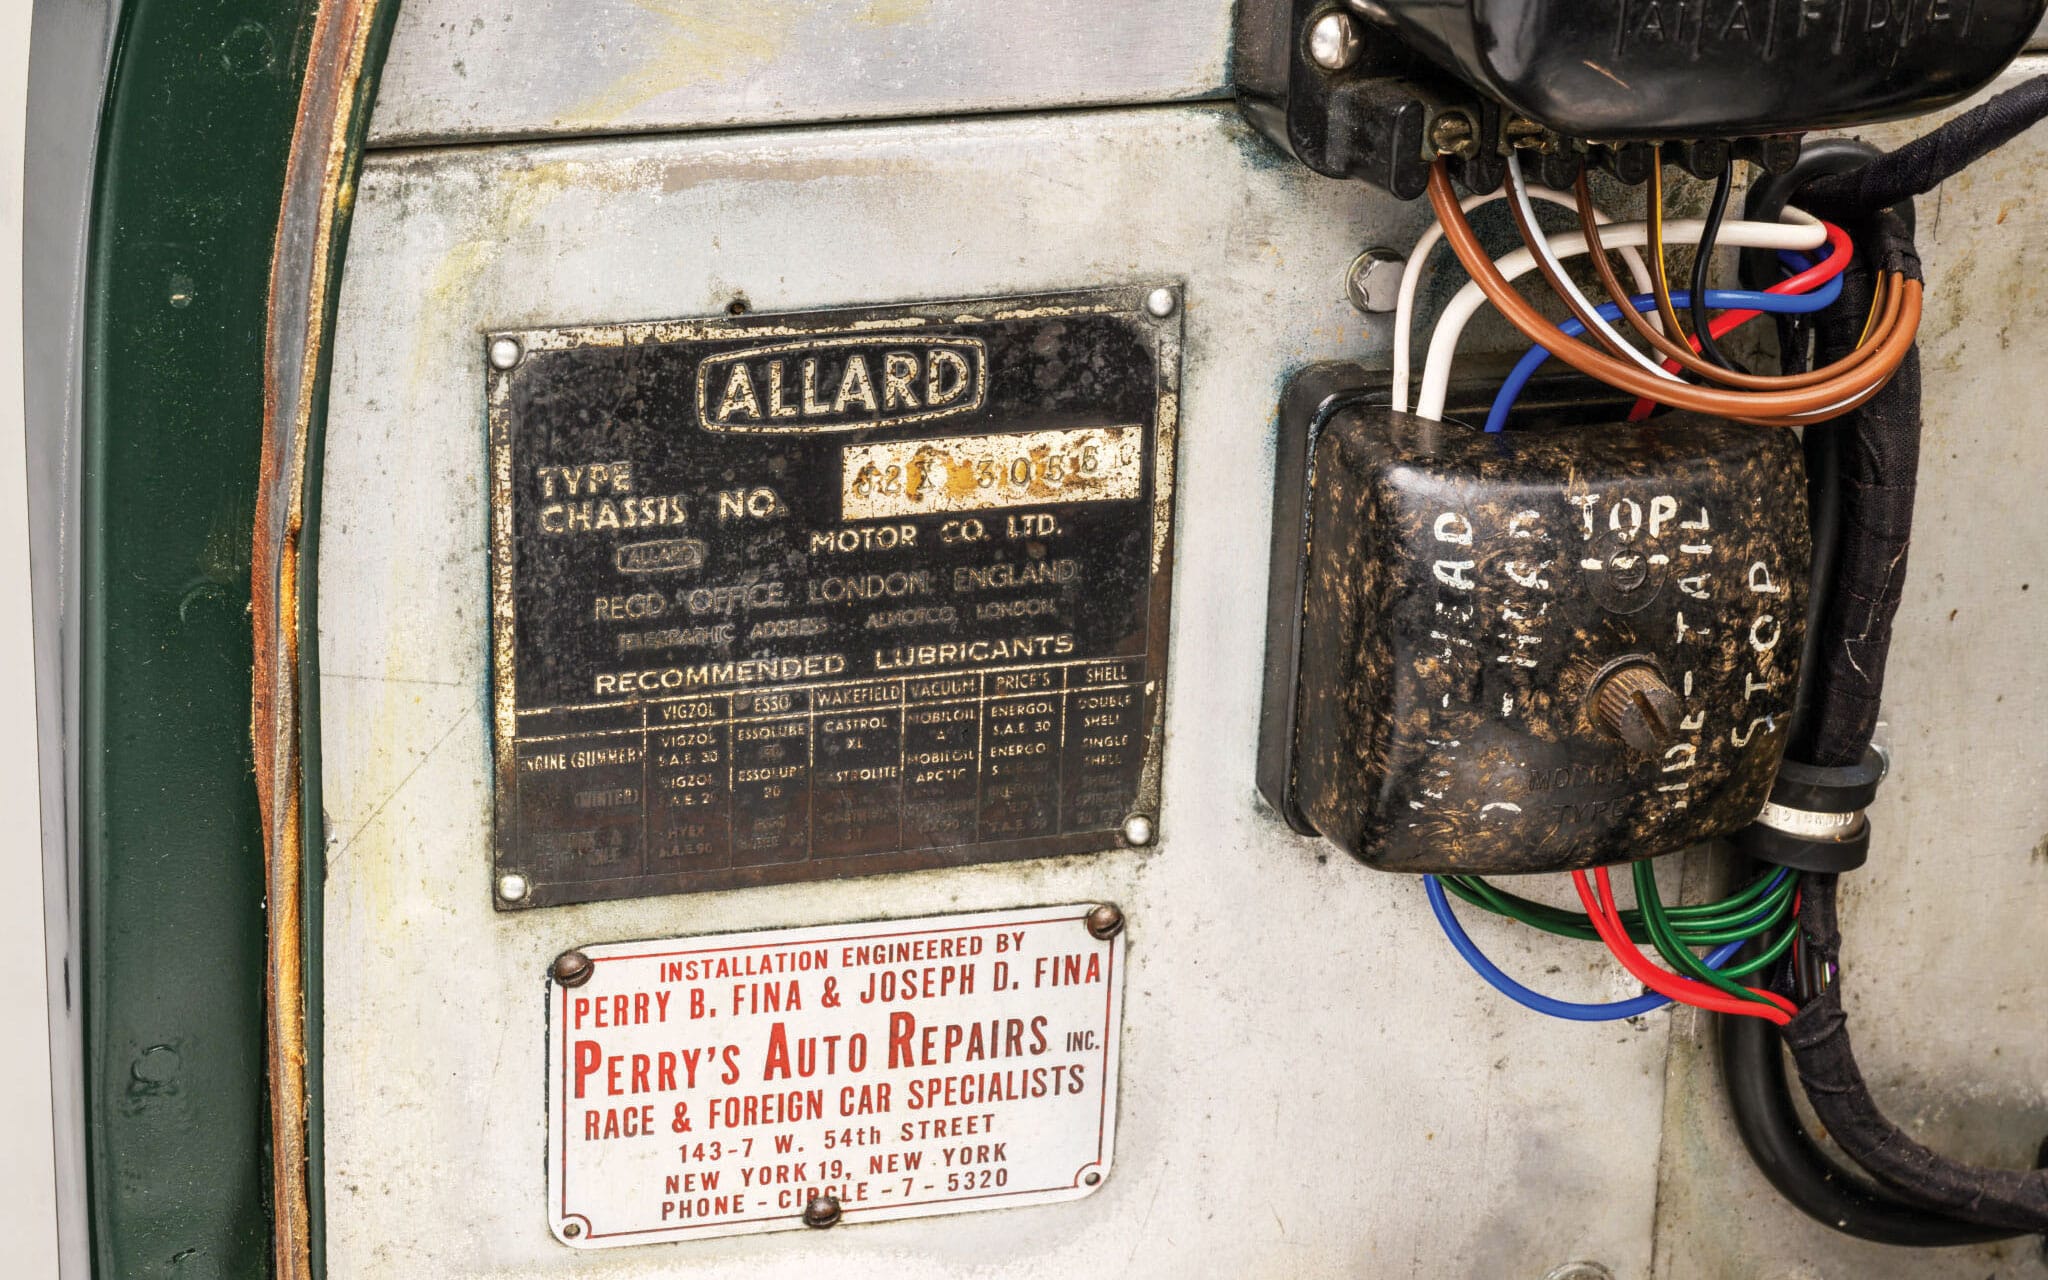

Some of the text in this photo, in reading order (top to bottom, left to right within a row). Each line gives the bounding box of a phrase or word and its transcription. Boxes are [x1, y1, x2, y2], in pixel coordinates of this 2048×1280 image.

[716, 349, 962, 423] ALLARD
[537, 461, 632, 497] TYPE
[540, 495, 687, 534] CHASSIS
[810, 514, 1062, 554] MOTOR CO. LTD.
[1569, 493, 1679, 541] TOP
[595, 633, 1074, 694] RECOMMENDED LUBRICANTS
[1731, 561, 1781, 749] STOP
[662, 665, 1129, 721] VIGZOL ESSO WAKEFIELD VACUUM PRICE'S SHELL
[990, 702, 1054, 718] ENERGOL
[661, 732, 717, 748] VIGZOL
[738, 723, 805, 741] ESSOLUBE
[823, 717, 888, 733] CASTROL
[1035, 720, 1051, 732] 30
[702, 749, 718, 763] 30
[990, 742, 1048, 758] ENERGO
[661, 773, 713, 789] IGZO
[738, 764, 805, 782] ESSOU
[818, 765, 898, 783] STROLITE
[660, 931, 1026, 983] INSTALLATION ENGINEERED BY
[575, 952, 1101, 1030] PERRY B. FINA & JOSEPH D. FINA
[575, 1011, 1100, 1099] PERRY'S AUTO REPAIRS INC.
[585, 1064, 1085, 1141] RACE & FOREIGN CAR SPECIALISTS
[679, 1114, 996, 1164] 143-7 W. 54th STREET
[665, 1142, 1008, 1194] NEW YORK 19, NEW YORK
[662, 1194, 745, 1221] PHONE
[902, 1177, 914, 1197] 7
[947, 1168, 1008, 1192] 5320
